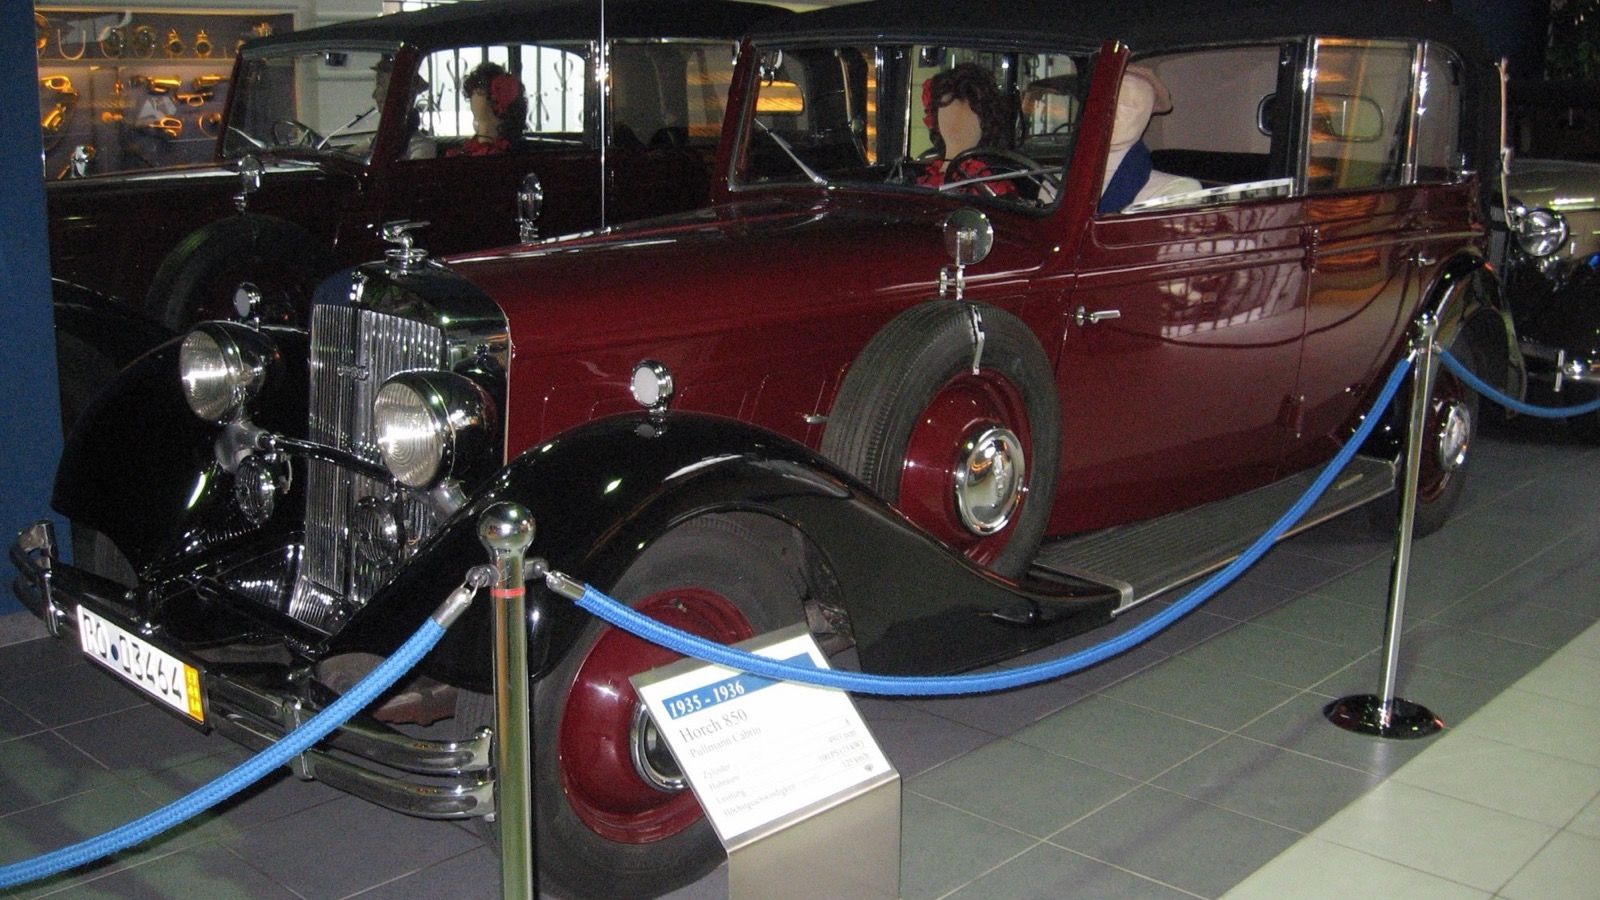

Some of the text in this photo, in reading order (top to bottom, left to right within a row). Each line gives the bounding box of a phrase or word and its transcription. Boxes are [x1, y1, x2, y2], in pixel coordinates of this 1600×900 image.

[669, 694, 702, 718] 1935
[713, 680, 745, 703] 1936
[680, 708, 748, 743] Horch 850
